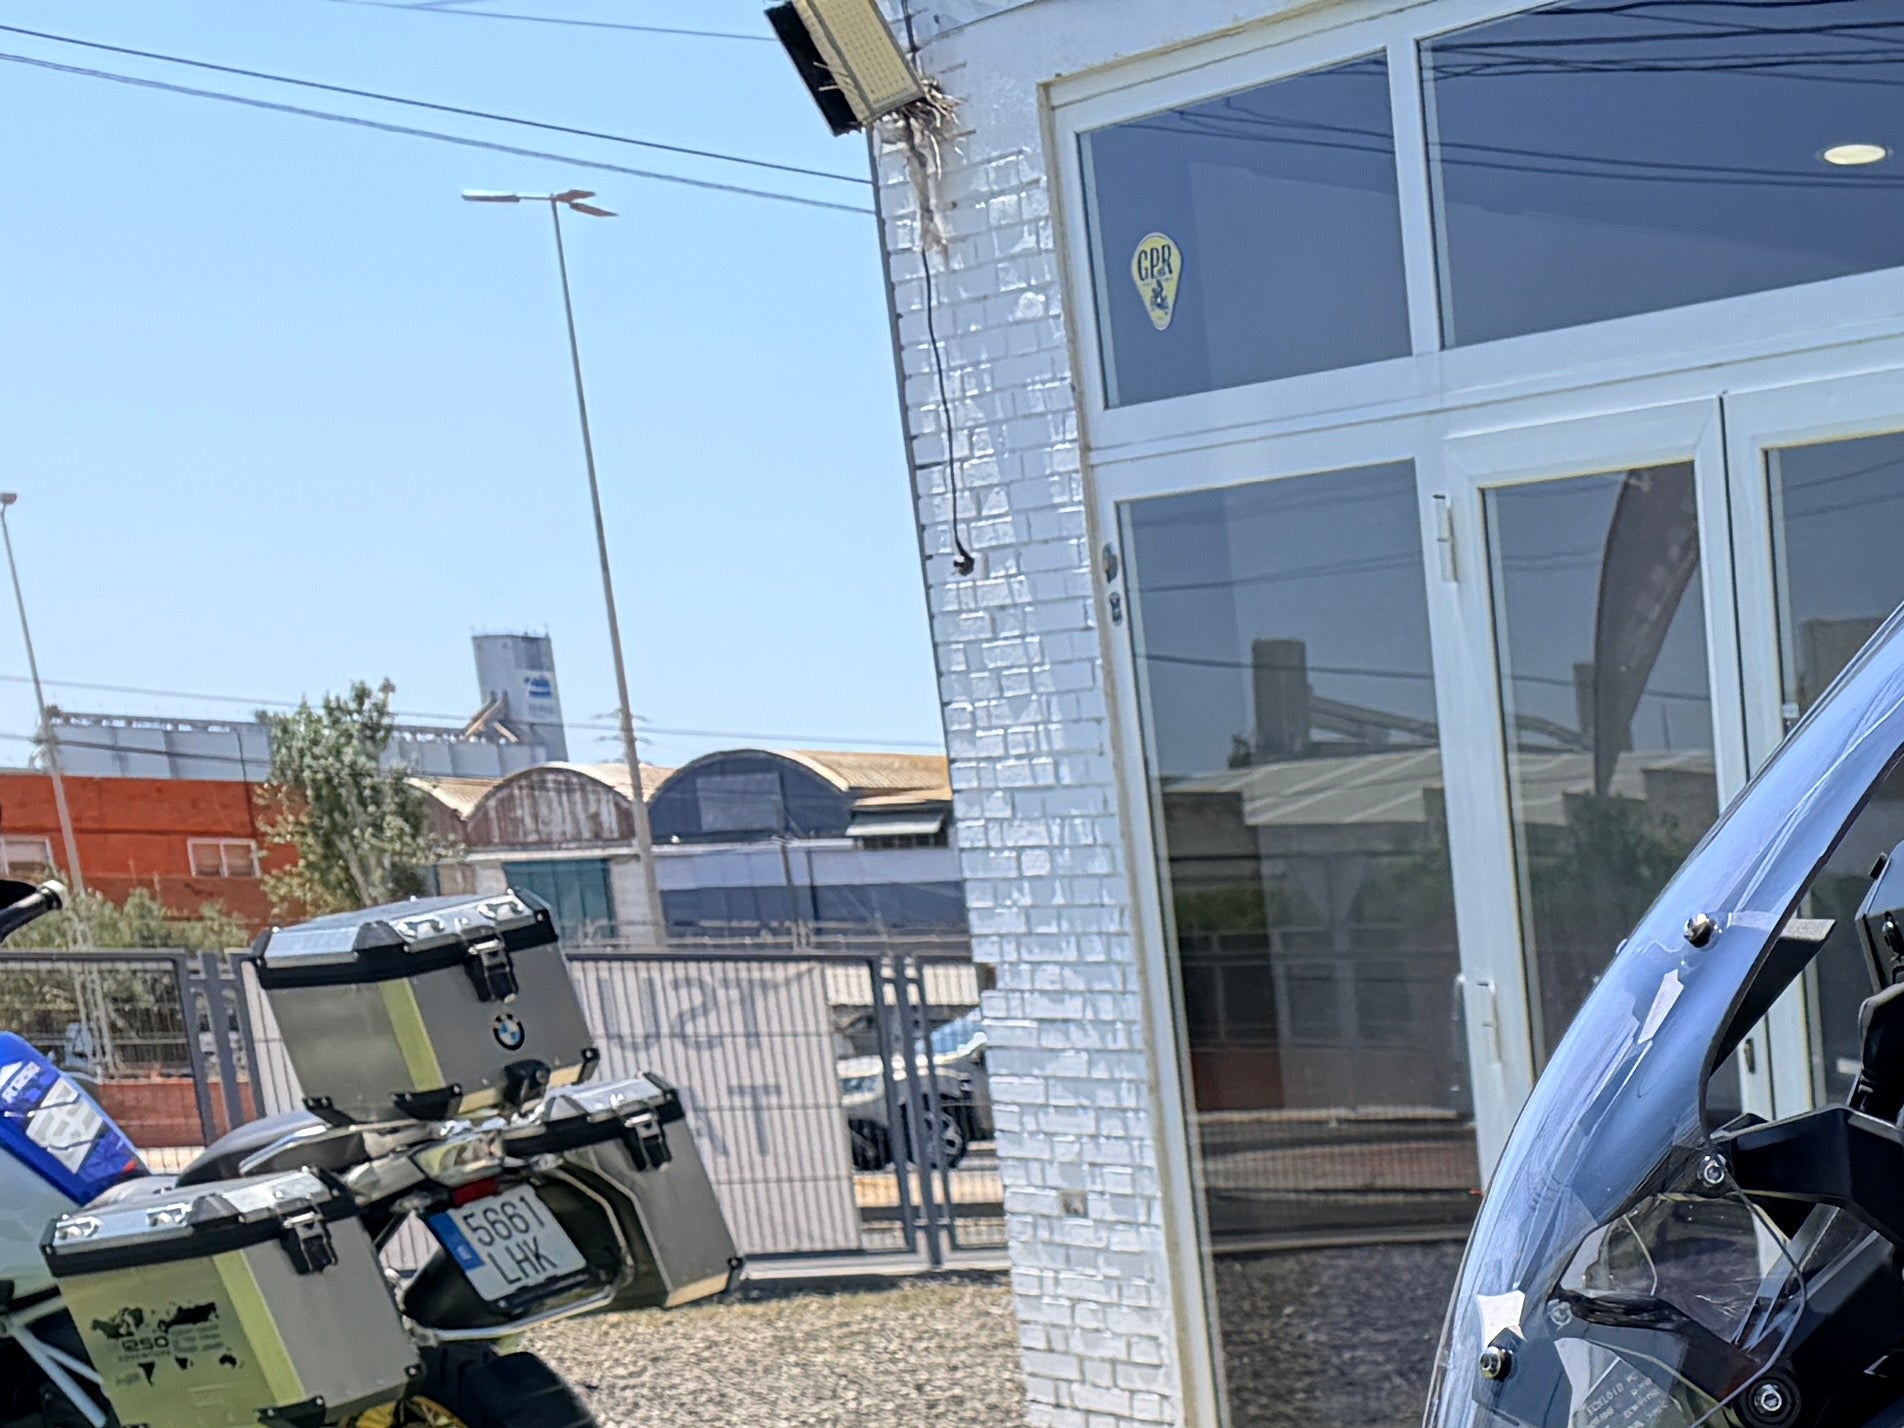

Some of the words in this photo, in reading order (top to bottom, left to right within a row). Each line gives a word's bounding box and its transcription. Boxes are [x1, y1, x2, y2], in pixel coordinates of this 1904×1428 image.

[1137, 243, 1173, 282] GPR
[462, 1195, 545, 1247] 5661
[486, 1235, 558, 1286] LHK
